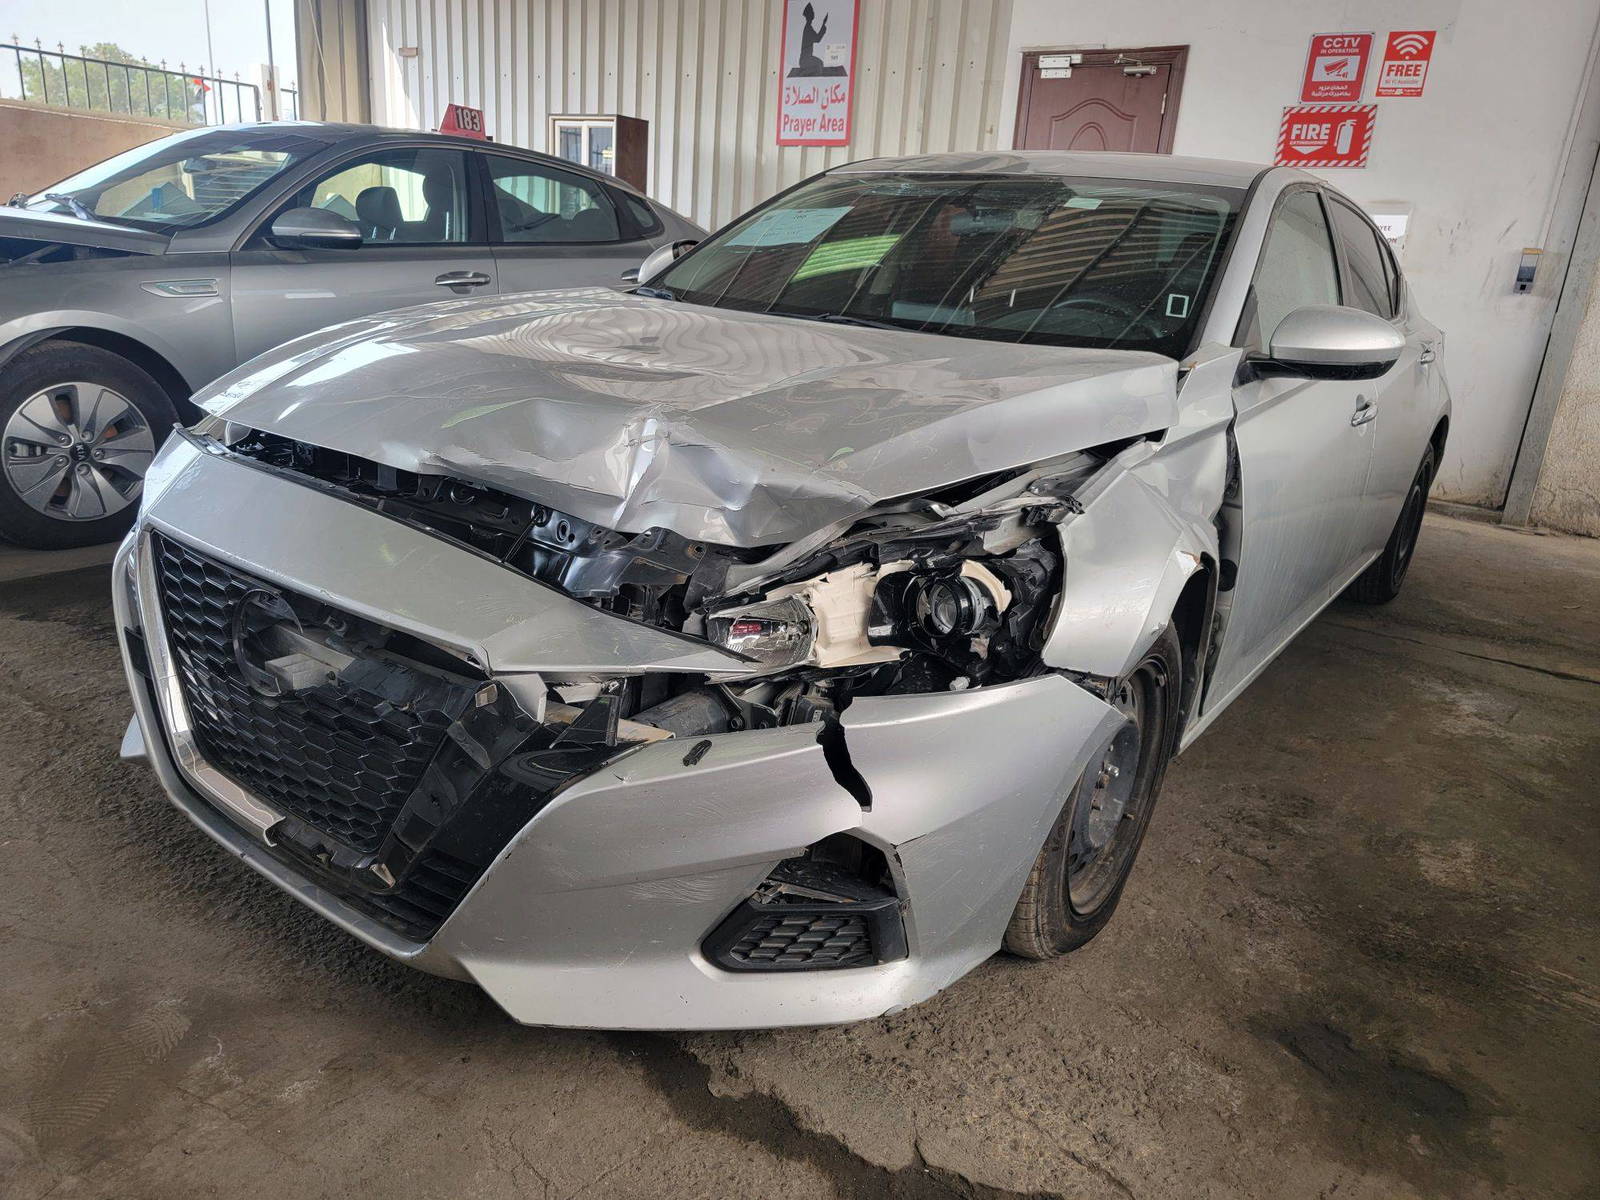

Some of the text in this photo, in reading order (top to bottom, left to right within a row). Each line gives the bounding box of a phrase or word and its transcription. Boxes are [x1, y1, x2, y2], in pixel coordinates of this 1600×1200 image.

[1323, 37, 1360, 48] CCTV
[1386, 64, 1421, 77] FREE
[785, 84, 845, 109] مكان الصلاة
[457, 108, 480, 131] 183
[783, 114, 844, 136] Prayer Area
[1291, 124, 1331, 140] FIRE
